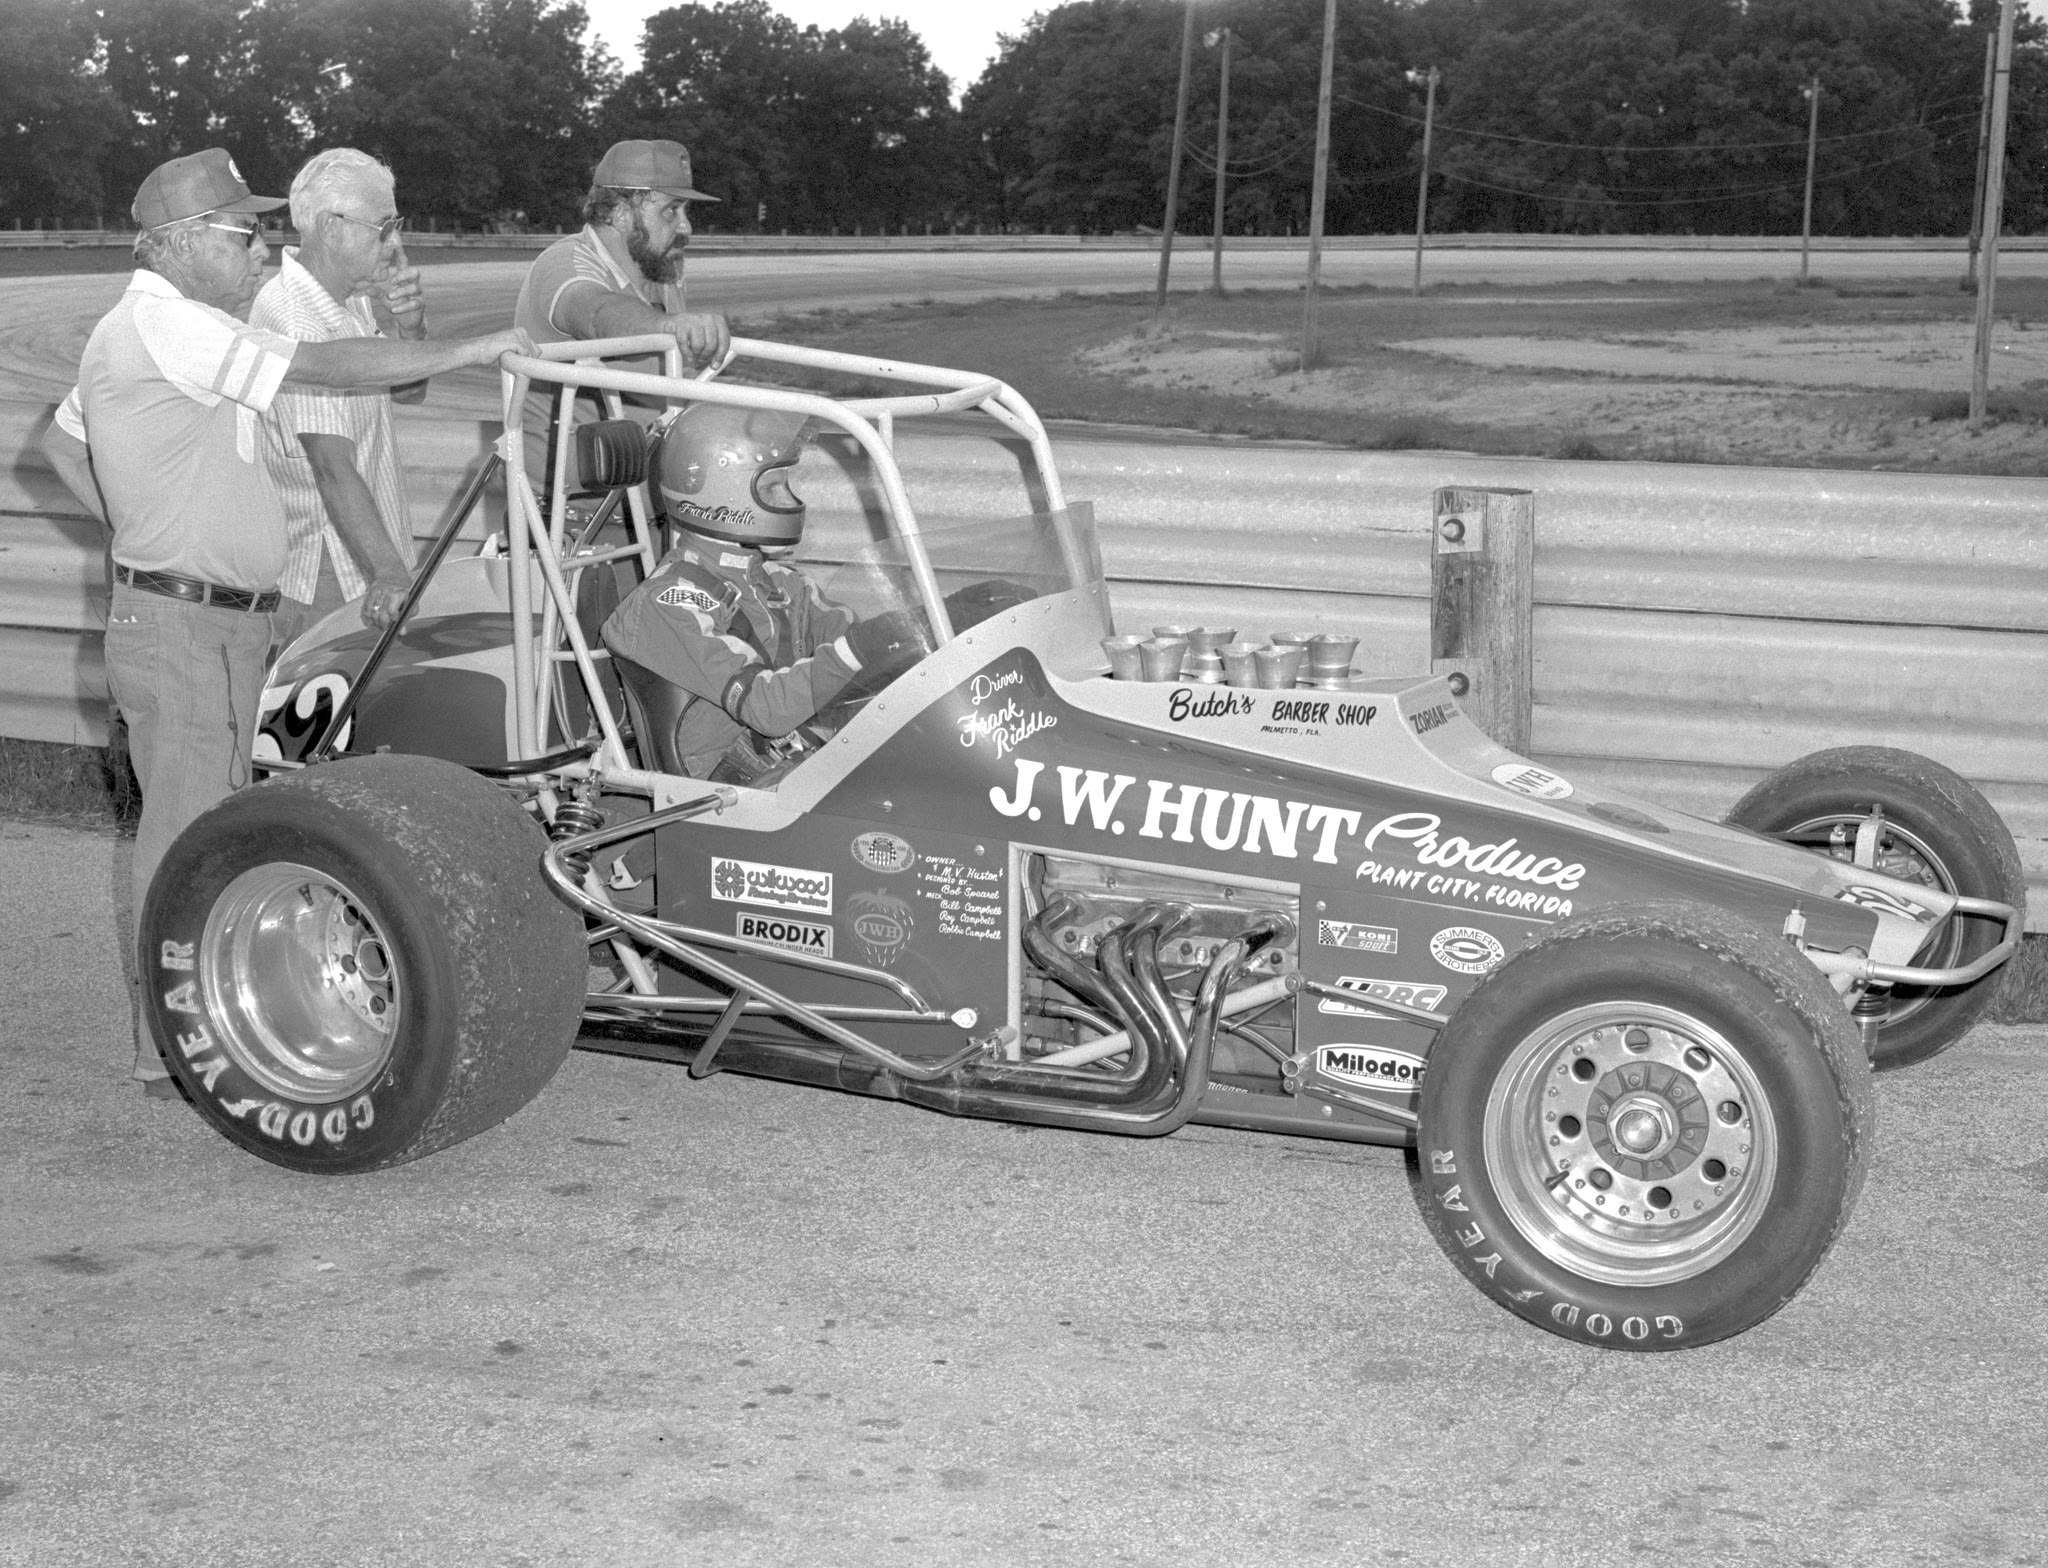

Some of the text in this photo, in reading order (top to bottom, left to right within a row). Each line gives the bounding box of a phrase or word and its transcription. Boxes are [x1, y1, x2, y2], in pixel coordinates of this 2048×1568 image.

[677, 500, 755, 525] Frank Riddle
[971, 670, 1023, 705] Driver
[1169, 688, 1377, 726] Butch's BARBER SHOP
[957, 697, 1024, 747] Frank
[1409, 704, 1447, 735] ZORIAN
[993, 711, 1058, 760] Riddle
[1306, 728, 1321, 737] FLA.
[1506, 768, 1555, 793] JWH
[1139, 779, 1362, 864] HUNT
[1364, 812, 1586, 891] Produce
[925, 874, 956, 884] DESIGNED
[941, 884, 962, 895] Bob
[1356, 861, 1573, 917] PLANT CITY, FLORIDA
[940, 899, 1002, 916] Bill Campbell
[960, 912, 996, 926] Campbell
[742, 918, 826, 947] BRODIX
[859, 922, 898, 939] JWH
[965, 926, 1002, 941] Campbell
[1358, 930, 1391, 941] KONI
[1436, 929, 1500, 952] SUMMERS
[805, 947, 824, 955] HEADS
[1358, 940, 1391, 951] sport
